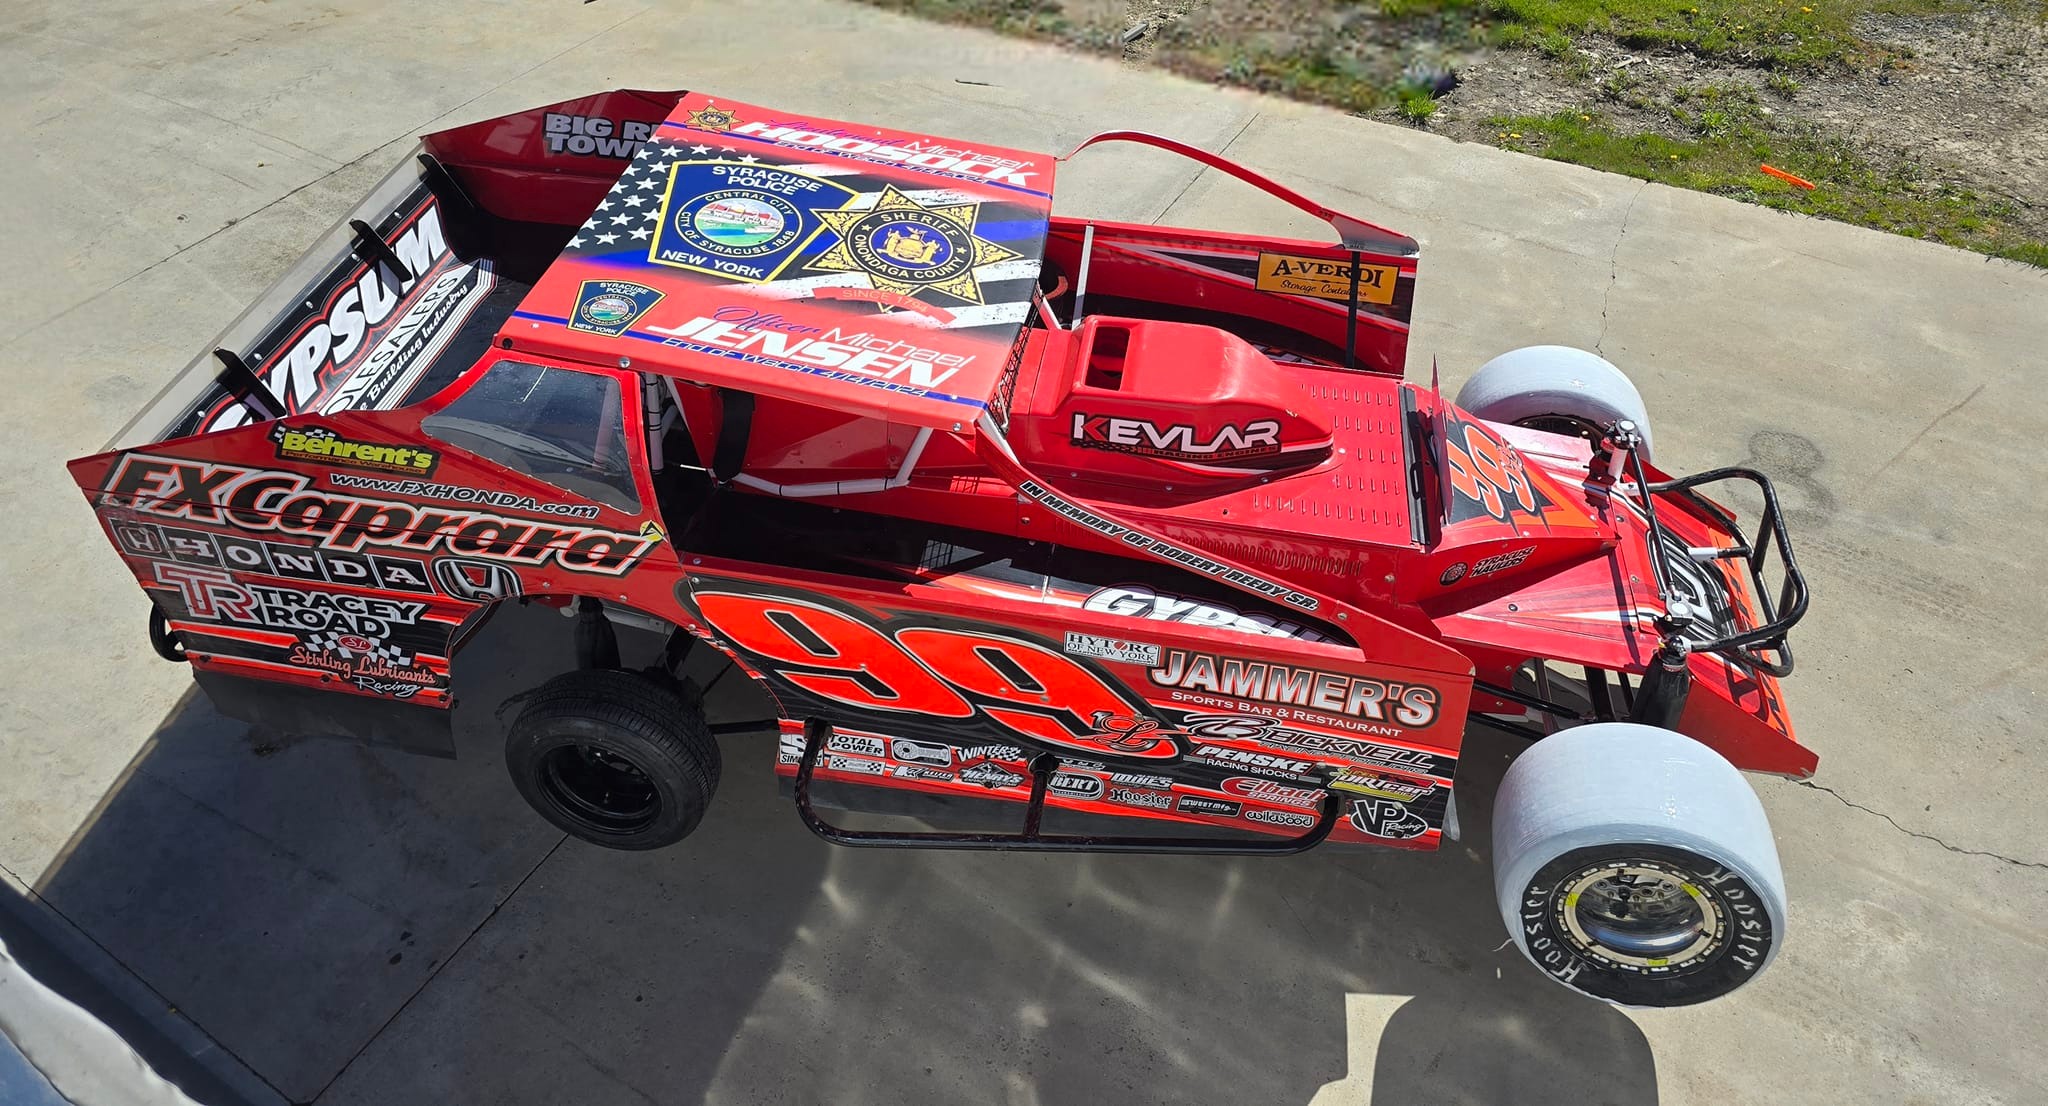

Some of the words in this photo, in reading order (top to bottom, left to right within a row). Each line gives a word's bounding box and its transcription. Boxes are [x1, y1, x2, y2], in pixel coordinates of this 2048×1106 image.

[546, 114, 613, 137] BIG
[732, 121, 1039, 186] HOOSOCK
[904, 141, 1036, 168] Michael
[712, 165, 823, 193] SYRACUSE
[728, 176, 799, 195] POLICE
[705, 191, 766, 201] CENTRAL
[769, 199, 794, 215] CITY
[680, 211, 691, 228] CITY
[881, 213, 959, 237] SHERIFF
[685, 229, 699, 240] OF
[772, 230, 795, 248] 1848
[699, 240, 770, 256] SYRACUSE
[854, 234, 909, 279] ONONDAGA
[913, 257, 965, 279] COUNTY
[662, 250, 707, 266] NEW
[713, 259, 764, 279] YORK
[600, 282, 649, 294] SYRACUSE
[606, 287, 639, 297] POLICE
[1280, 279, 1317, 293] Storage
[842, 289, 889, 301] SINCE
[897, 297, 929, 313] 1794
[574, 322, 594, 331] NEW
[595, 326, 618, 335] YORK
[713, 305, 818, 335] Officer
[367, 335, 424, 400] Building
[421, 284, 469, 339] Industry
[646, 316, 960, 388] JENSEN
[661, 337, 699, 353] End
[820, 328, 976, 368] Michael
[1073, 414, 1279, 453] KEVLAR
[282, 432, 433, 468] Behrent's
[1446, 425, 1536, 519] 99
[330, 473, 600, 519] www.FXHONDA.com
[1020, 481, 1043, 498] IN
[1041, 490, 1124, 536] MEMORY
[1122, 531, 1151, 548] OF
[1148, 541, 1230, 575] ROBERT
[1223, 566, 1289, 598] REEDY
[1284, 592, 1319, 610] SR.
[1476, 546, 1537, 568] SYRACUSE
[168, 535, 428, 587] HONDA
[1470, 557, 1528, 578] HAULERS
[153, 561, 262, 623] TR
[252, 587, 428, 624] TRACEY
[266, 604, 390, 638] ROAD
[1068, 632, 1159, 654] HYTORC
[1068, 642, 1083, 653] OF
[1084, 645, 1115, 658] NEW
[1116, 650, 1155, 664] YORK
[289, 647, 351, 677] Stirling
[354, 657, 436, 683] Lubricants
[696, 592, 1179, 759] 99
[351, 676, 421, 697] Racing
[1152, 649, 1438, 727] JAMMER'S
[1172, 691, 1233, 710] SPORTS
[1238, 702, 1272, 717] BAR
[1277, 707, 1290, 718] &
[1293, 709, 1403, 738] RESTAURANT
[831, 734, 876, 747] TOTAL
[832, 743, 883, 755] POWER
[1266, 729, 1435, 769] BICKNELL
[1197, 745, 1312, 774] PENSKE
[1206, 758, 1249, 773] RACING
[1250, 765, 1298, 781] SHOCKS
[1050, 775, 1098, 791] BERT
[1225, 777, 1329, 802] Eibach
[1347, 774, 1441, 795] DIRTcar
[1109, 788, 1173, 806] Hoosier
[1248, 791, 1317, 810] SPRINGS
[1246, 810, 1314, 827] wilwood
[1353, 799, 1418, 837] VP
[1385, 822, 1422, 832] Racing
[1698, 866, 1762, 970] Hoosier
[1525, 885, 1582, 984] Hoosier
